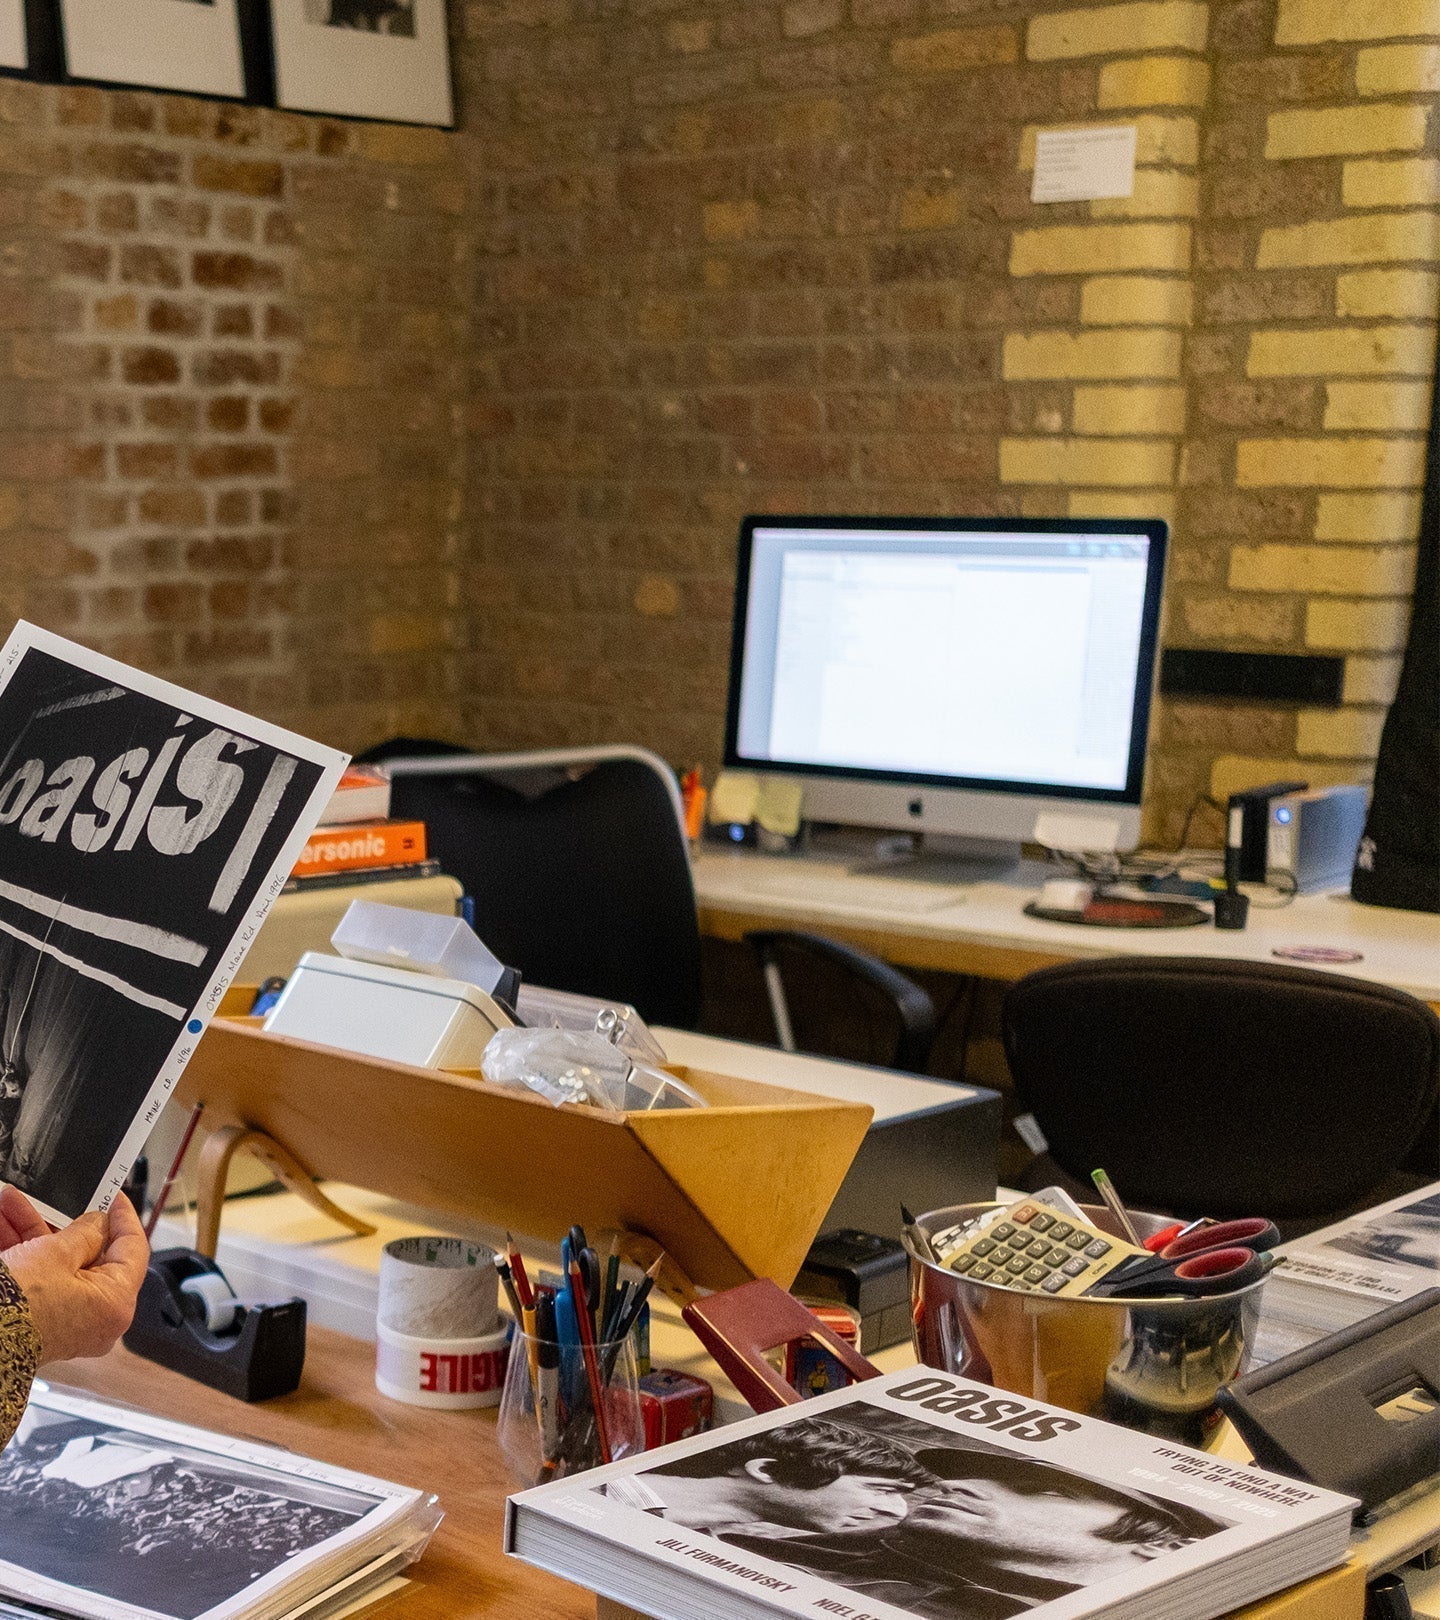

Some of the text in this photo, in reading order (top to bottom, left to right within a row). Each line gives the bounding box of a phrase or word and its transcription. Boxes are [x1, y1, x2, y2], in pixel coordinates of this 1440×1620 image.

[269, 873, 286, 897] 1996
[1152, 1446, 1321, 1502] TRYING TO FIND A WAY
[1170, 1462, 1303, 1509] OUT OF NOWHERE
[655, 1537, 798, 1594] JILL FURMANOVSKY
[812, 1597, 855, 1618] NOEL
